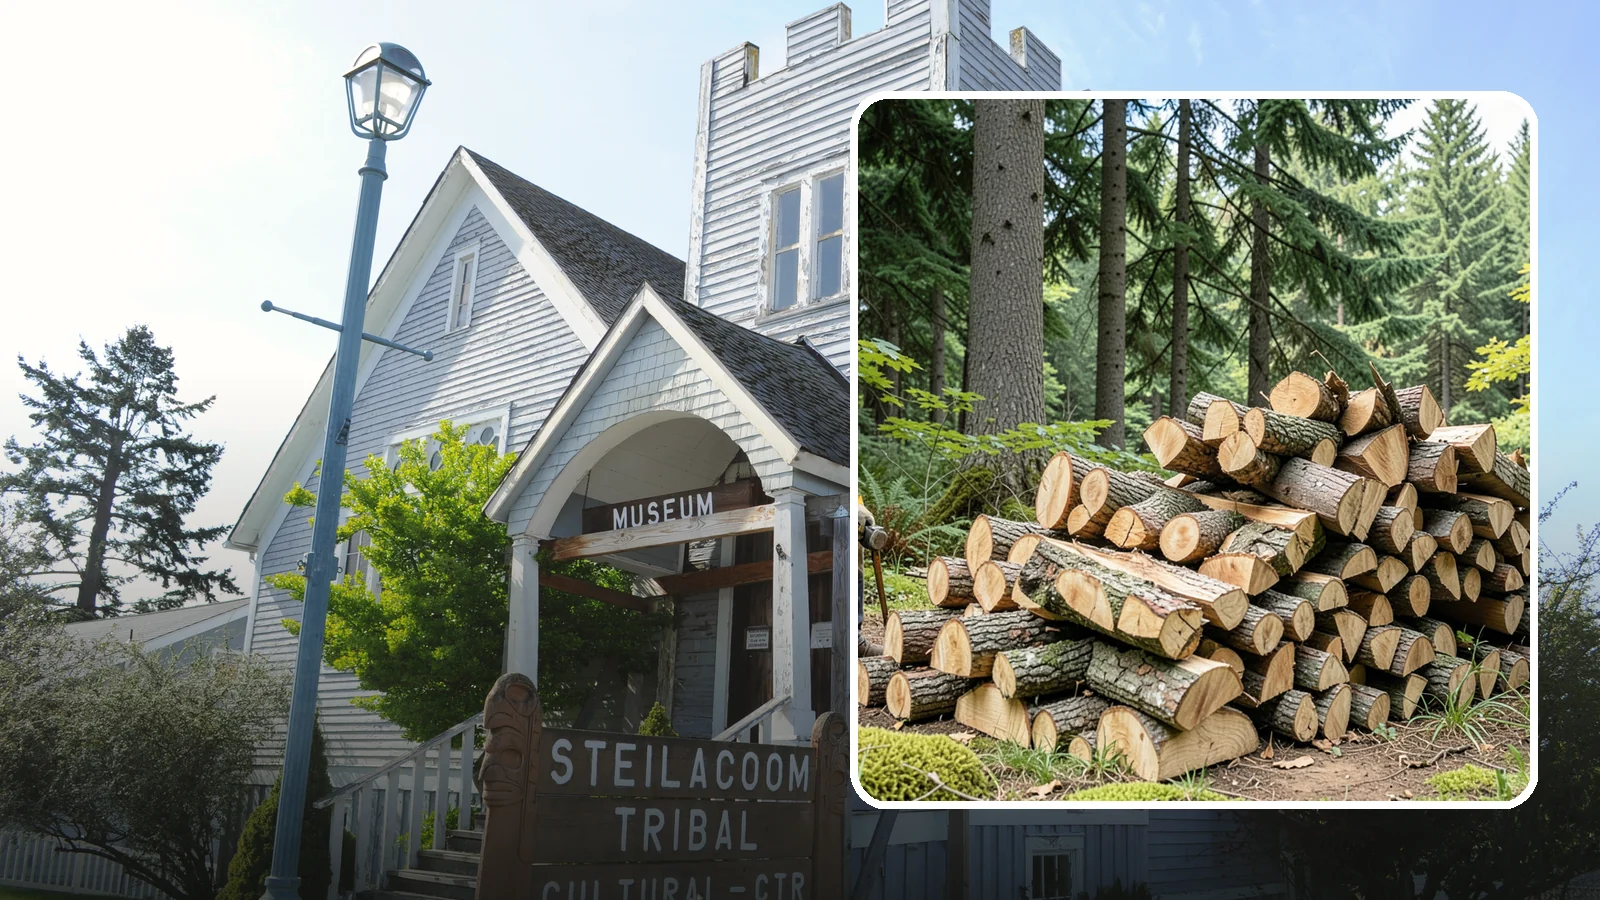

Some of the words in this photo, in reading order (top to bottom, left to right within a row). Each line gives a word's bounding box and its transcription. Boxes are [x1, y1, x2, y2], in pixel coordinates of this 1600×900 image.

[613, 491, 713, 531] MUSEUM
[550, 738, 809, 793] STEILACOOM
[615, 806, 757, 852] TRIBAL
